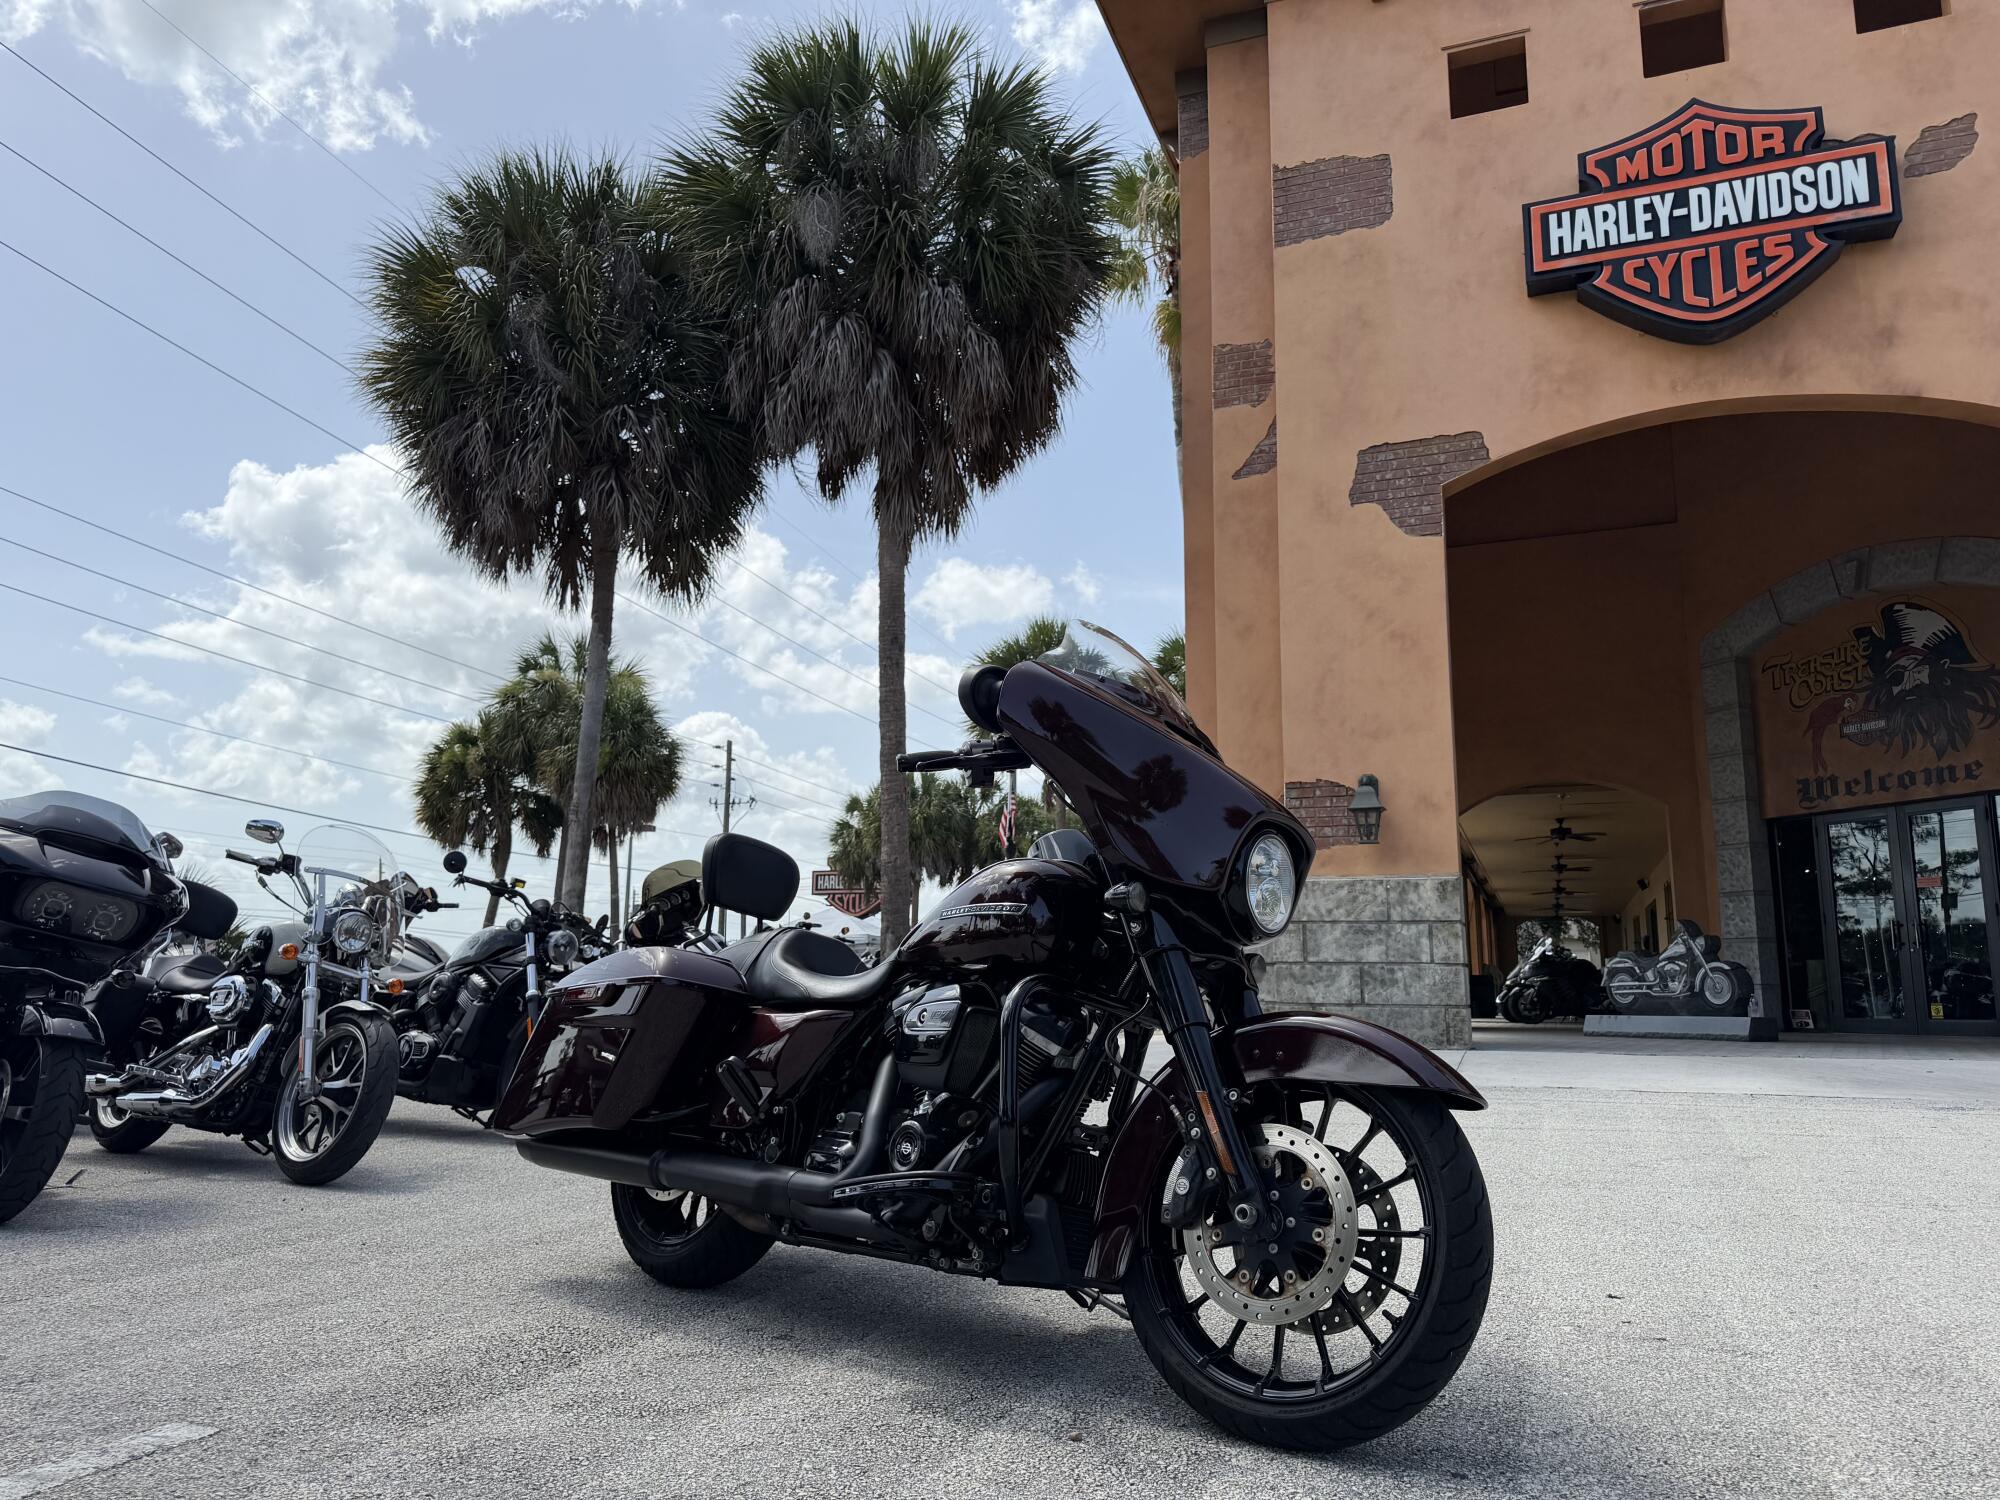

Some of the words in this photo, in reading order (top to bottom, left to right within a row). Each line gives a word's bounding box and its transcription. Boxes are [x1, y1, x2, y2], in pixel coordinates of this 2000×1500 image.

[1615, 118, 1786, 184] MOTOR
[1548, 157, 1870, 256] HARLEY-DAVIDSON
[1622, 233, 1795, 308] CYCLES
[1761, 636, 1873, 690] TREASURE
[1796, 759, 1985, 810] Welcome
[942, 905, 1020, 917] HARLEY-DAVIDSON
